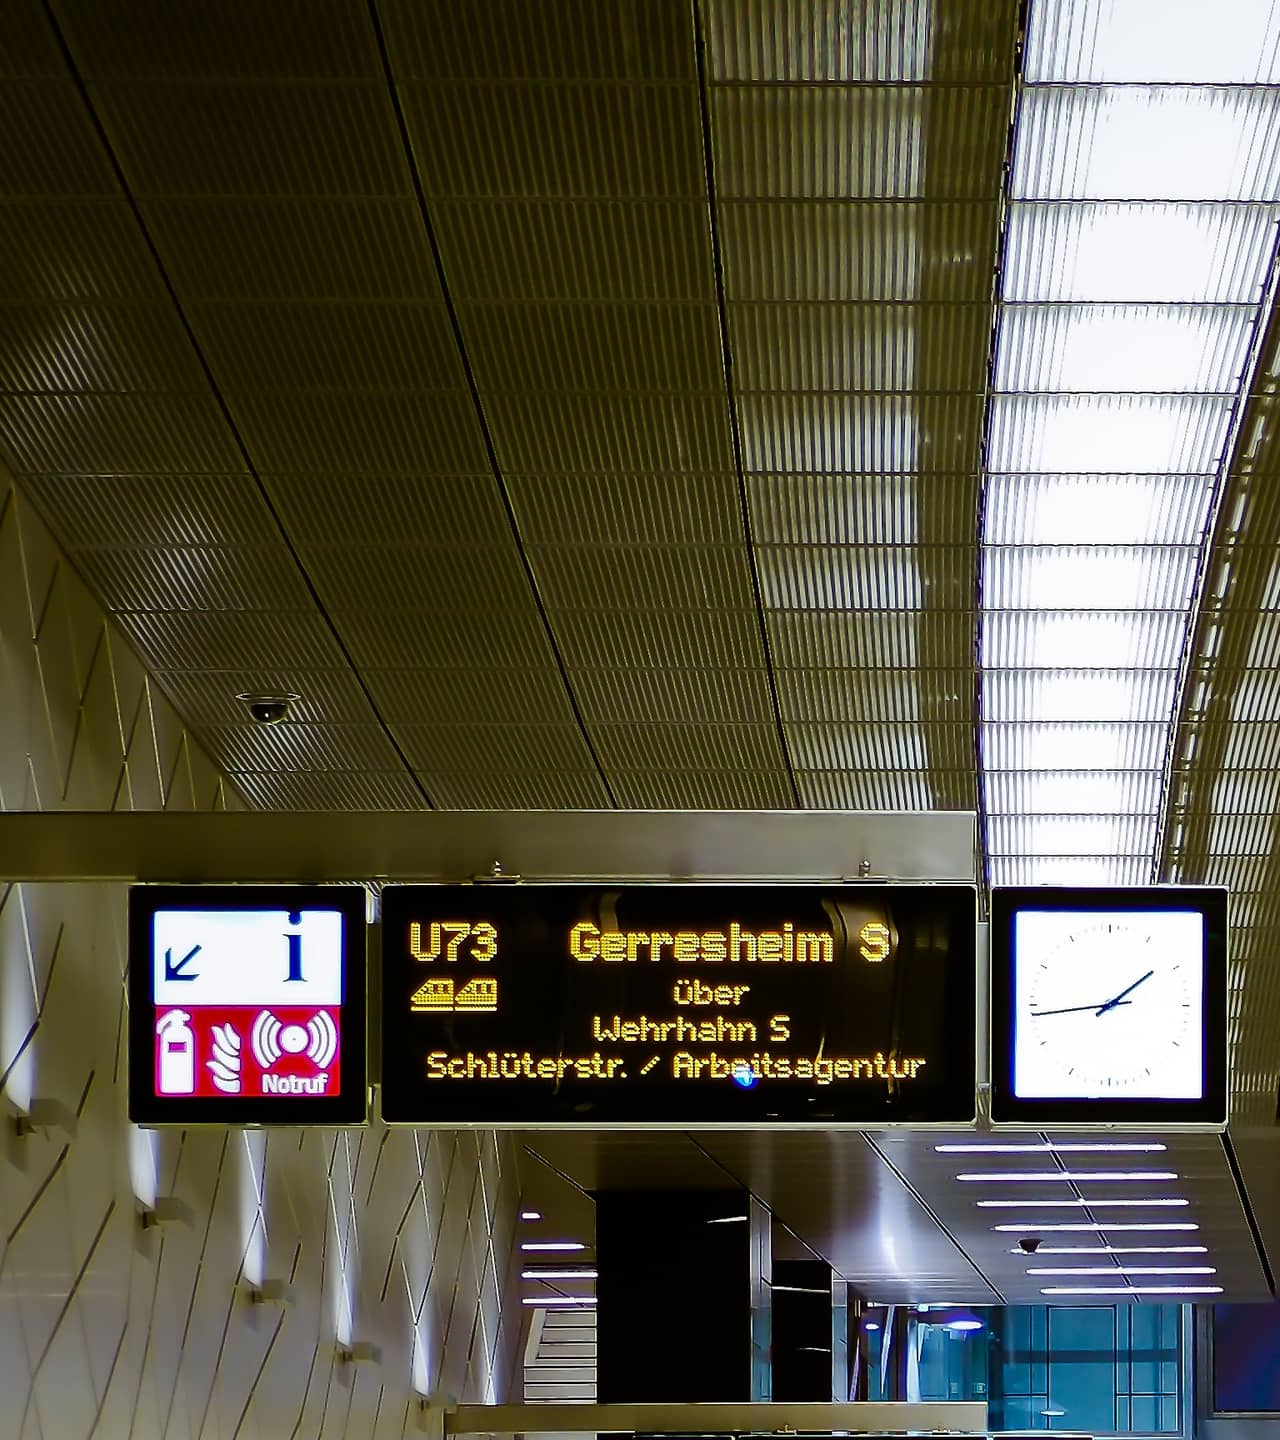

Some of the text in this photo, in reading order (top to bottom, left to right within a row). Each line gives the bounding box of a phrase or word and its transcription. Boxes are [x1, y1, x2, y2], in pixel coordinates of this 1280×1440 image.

[410, 922, 899, 962] U73 Gerresheim S
[673, 978, 750, 1006] über
[594, 1014, 790, 1042] Wehrhahn S
[427, 1052, 626, 1081] Schlüterstr.
[673, 1050, 926, 1085] Arbeitsagentur
[262, 1072, 329, 1094] Notruf
